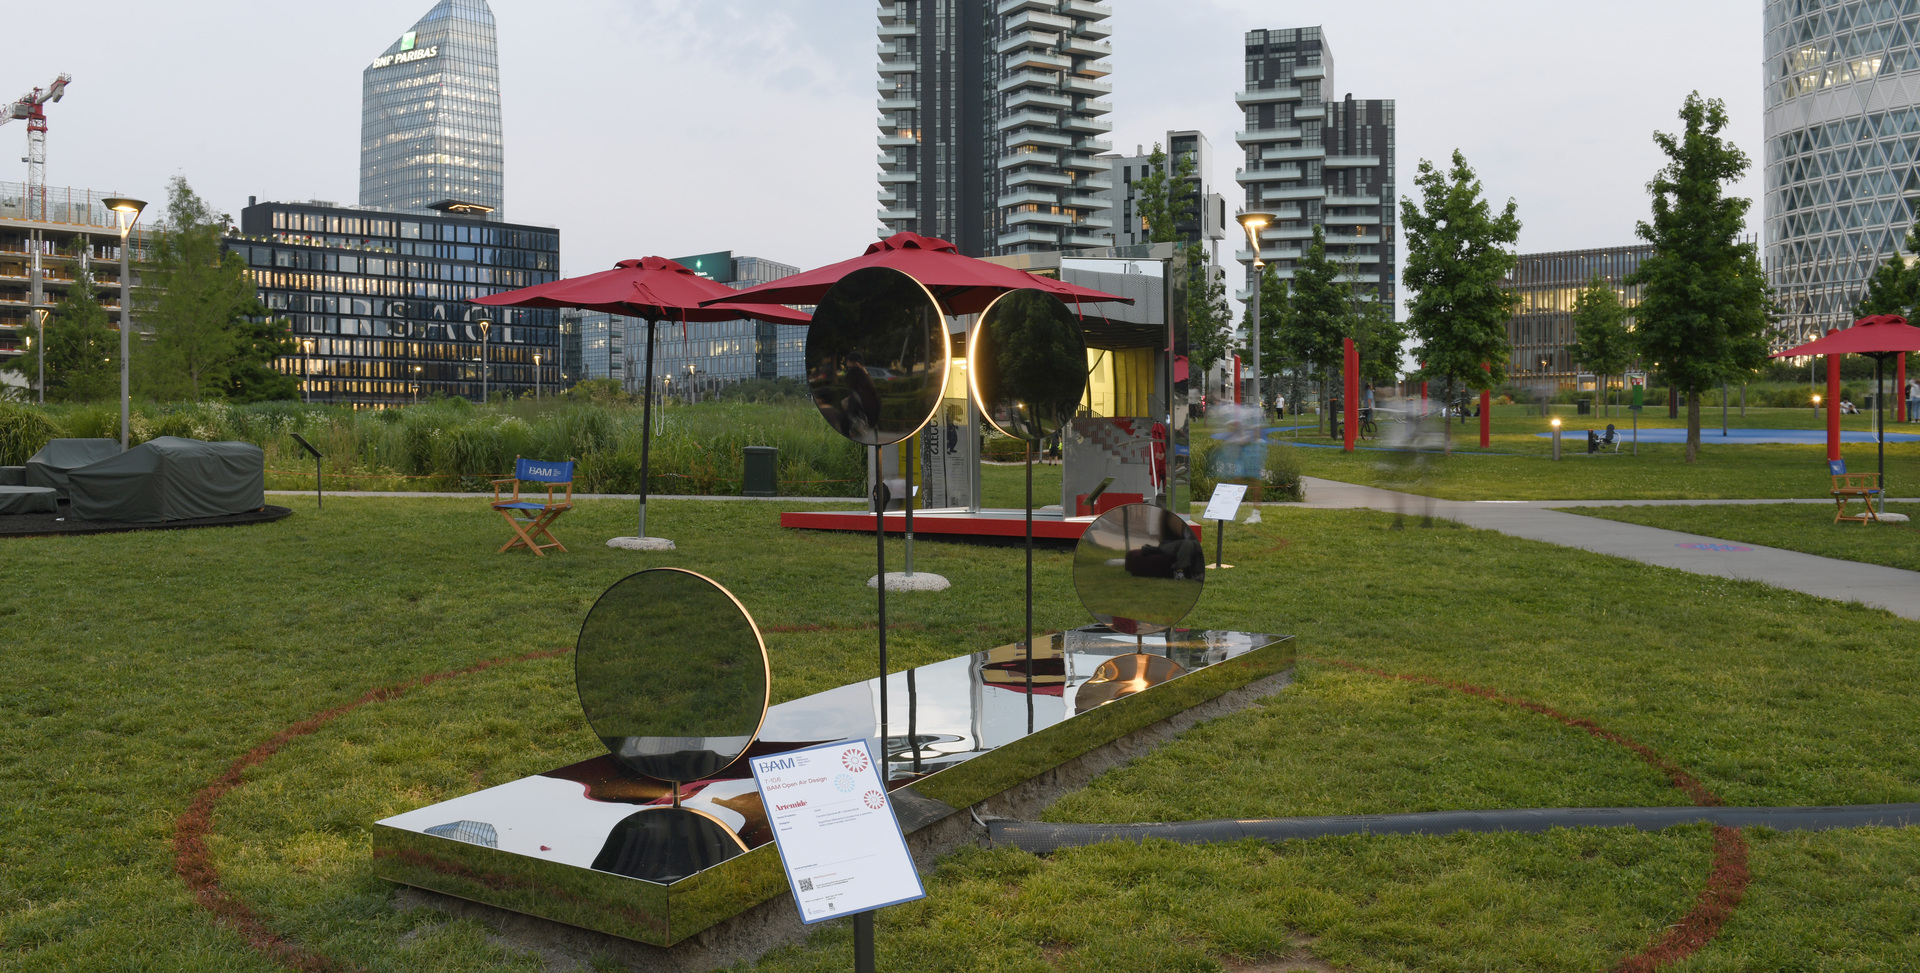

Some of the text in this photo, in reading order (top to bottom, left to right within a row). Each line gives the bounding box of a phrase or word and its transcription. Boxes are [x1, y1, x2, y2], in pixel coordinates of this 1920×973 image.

[373, 46, 437, 68] BNP PARIBAS
[529, 466, 552, 476] BAM
[759, 757, 795, 773] BAM
[808, 776, 828, 784] Design
[775, 800, 808, 811] Artemide
